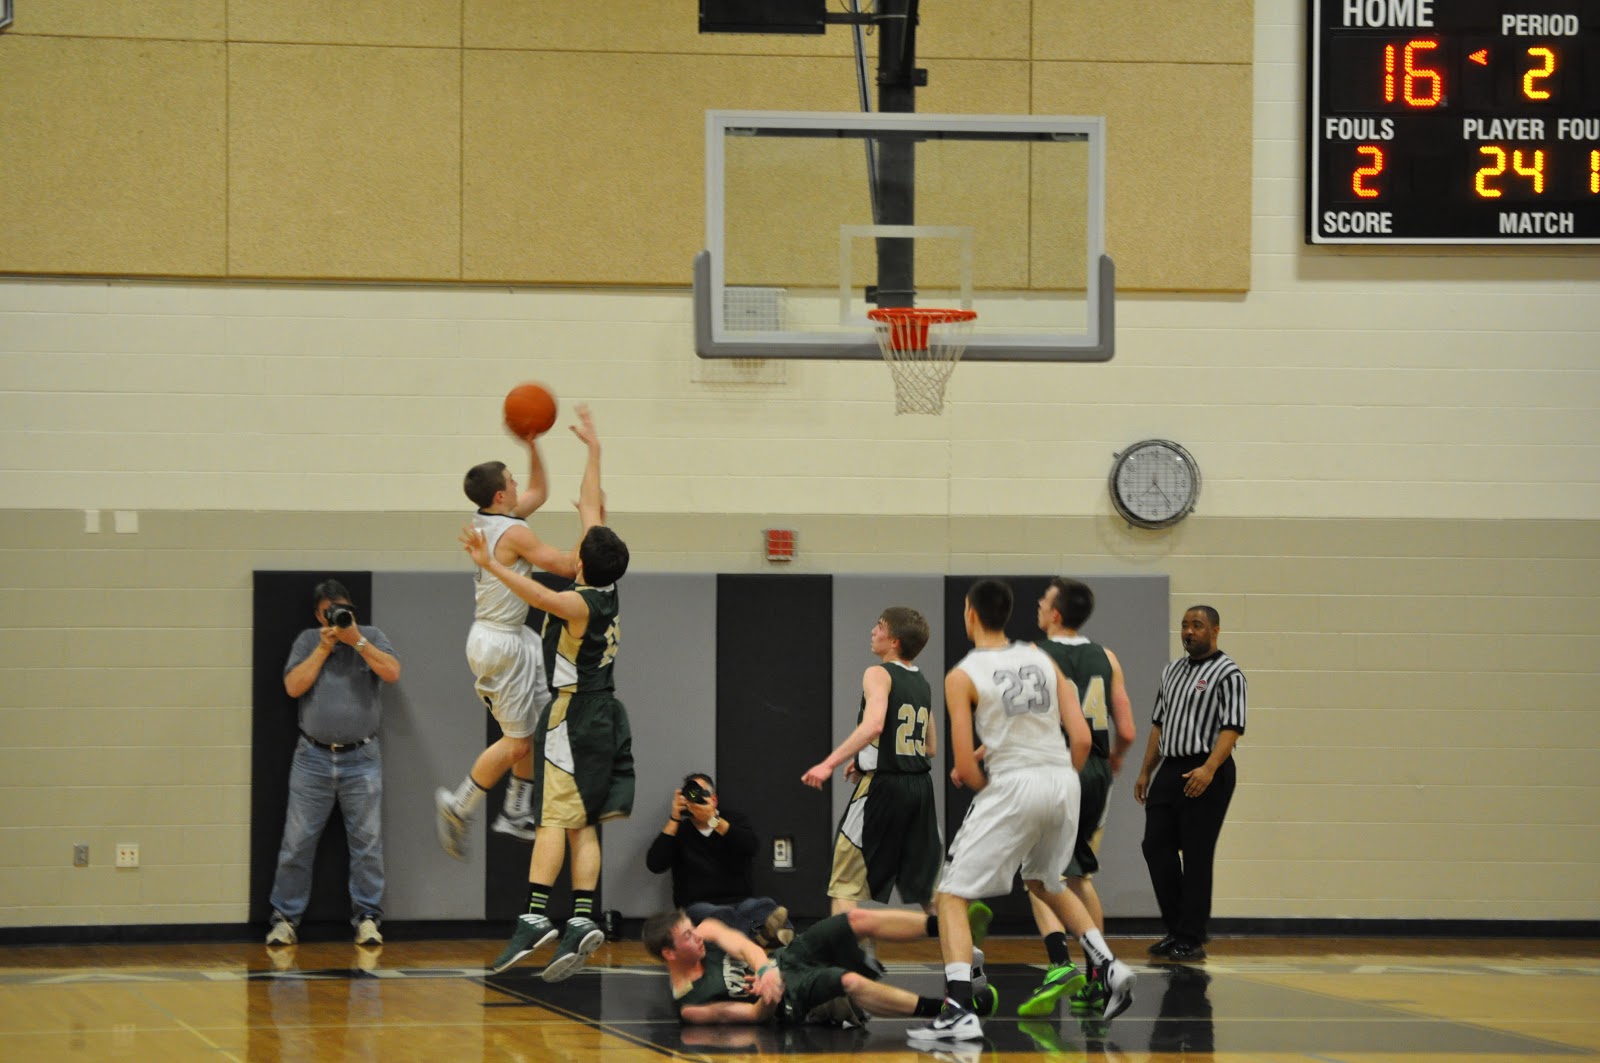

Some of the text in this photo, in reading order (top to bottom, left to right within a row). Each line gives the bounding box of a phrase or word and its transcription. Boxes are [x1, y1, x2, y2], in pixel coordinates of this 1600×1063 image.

[1342, 0, 1435, 27] HOME
[1502, 14, 1580, 36] PERIOD
[1384, 40, 1442, 107] 16
[1522, 47, 1555, 99] 2
[1325, 118, 1395, 140] FOULS
[1463, 118, 1600, 140] PLAYER FOU
[1352, 145, 1383, 198] 2
[1475, 145, 1544, 198] 24
[1323, 211, 1393, 234] SCORE
[1499, 212, 1575, 234] MATCH
[992, 664, 1051, 718] 23
[1066, 675, 1109, 731] 4
[895, 703, 929, 757] 23
